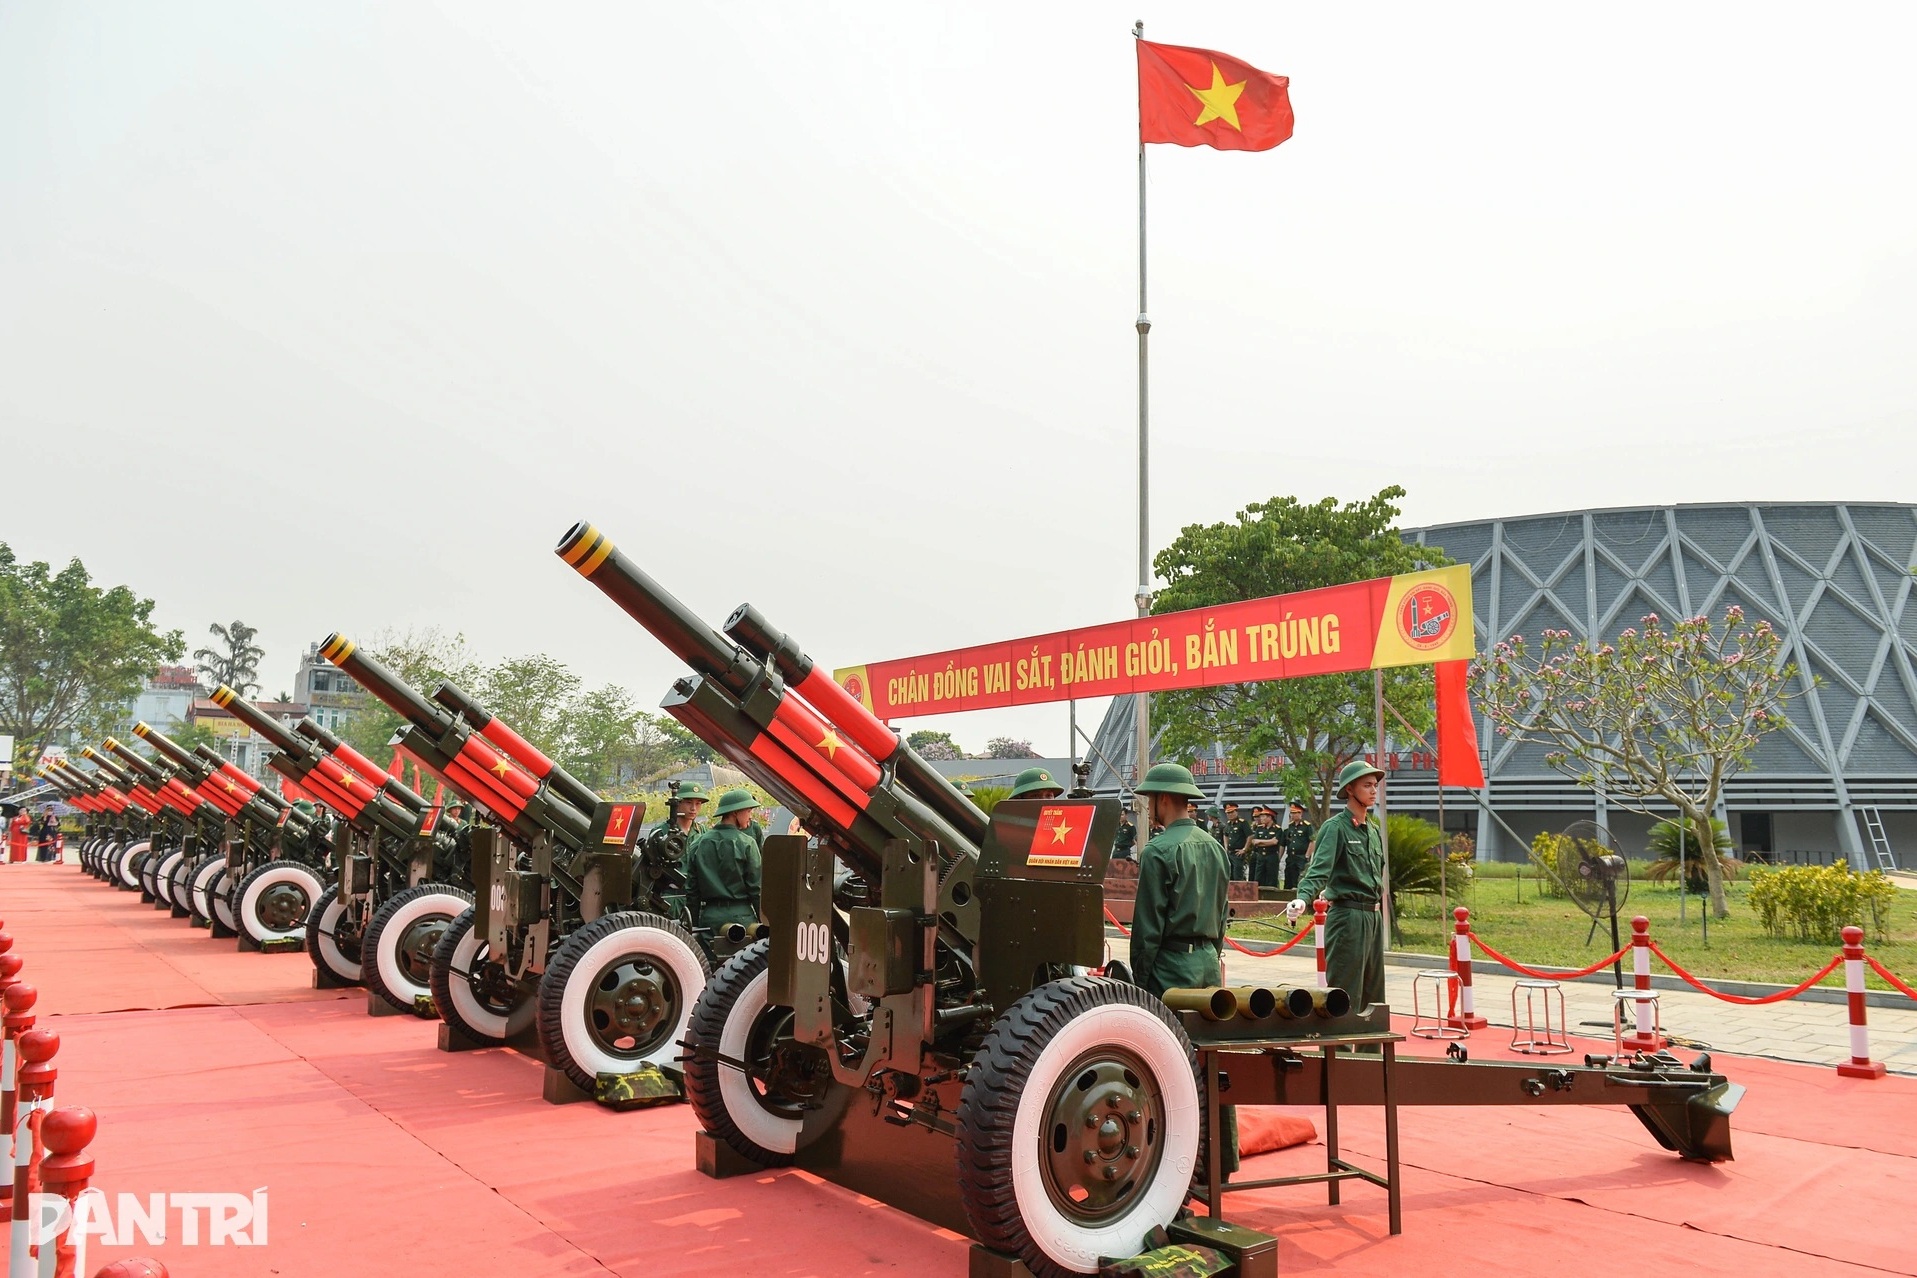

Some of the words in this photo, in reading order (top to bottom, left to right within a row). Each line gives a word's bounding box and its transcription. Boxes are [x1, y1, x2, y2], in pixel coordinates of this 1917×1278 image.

[888, 669, 929, 706] CHÂN
[933, 660, 978, 700] ĐỒNG
[983, 661, 1011, 694] VAI
[1016, 645, 1055, 690] SẮT,
[1060, 643, 1118, 685] ĐÁNH
[1125, 627, 1178, 676] GIỎI,
[1186, 617, 1239, 671] BẮN
[1245, 612, 1341, 663] TRÚNG
[796, 921, 829, 965] 009
